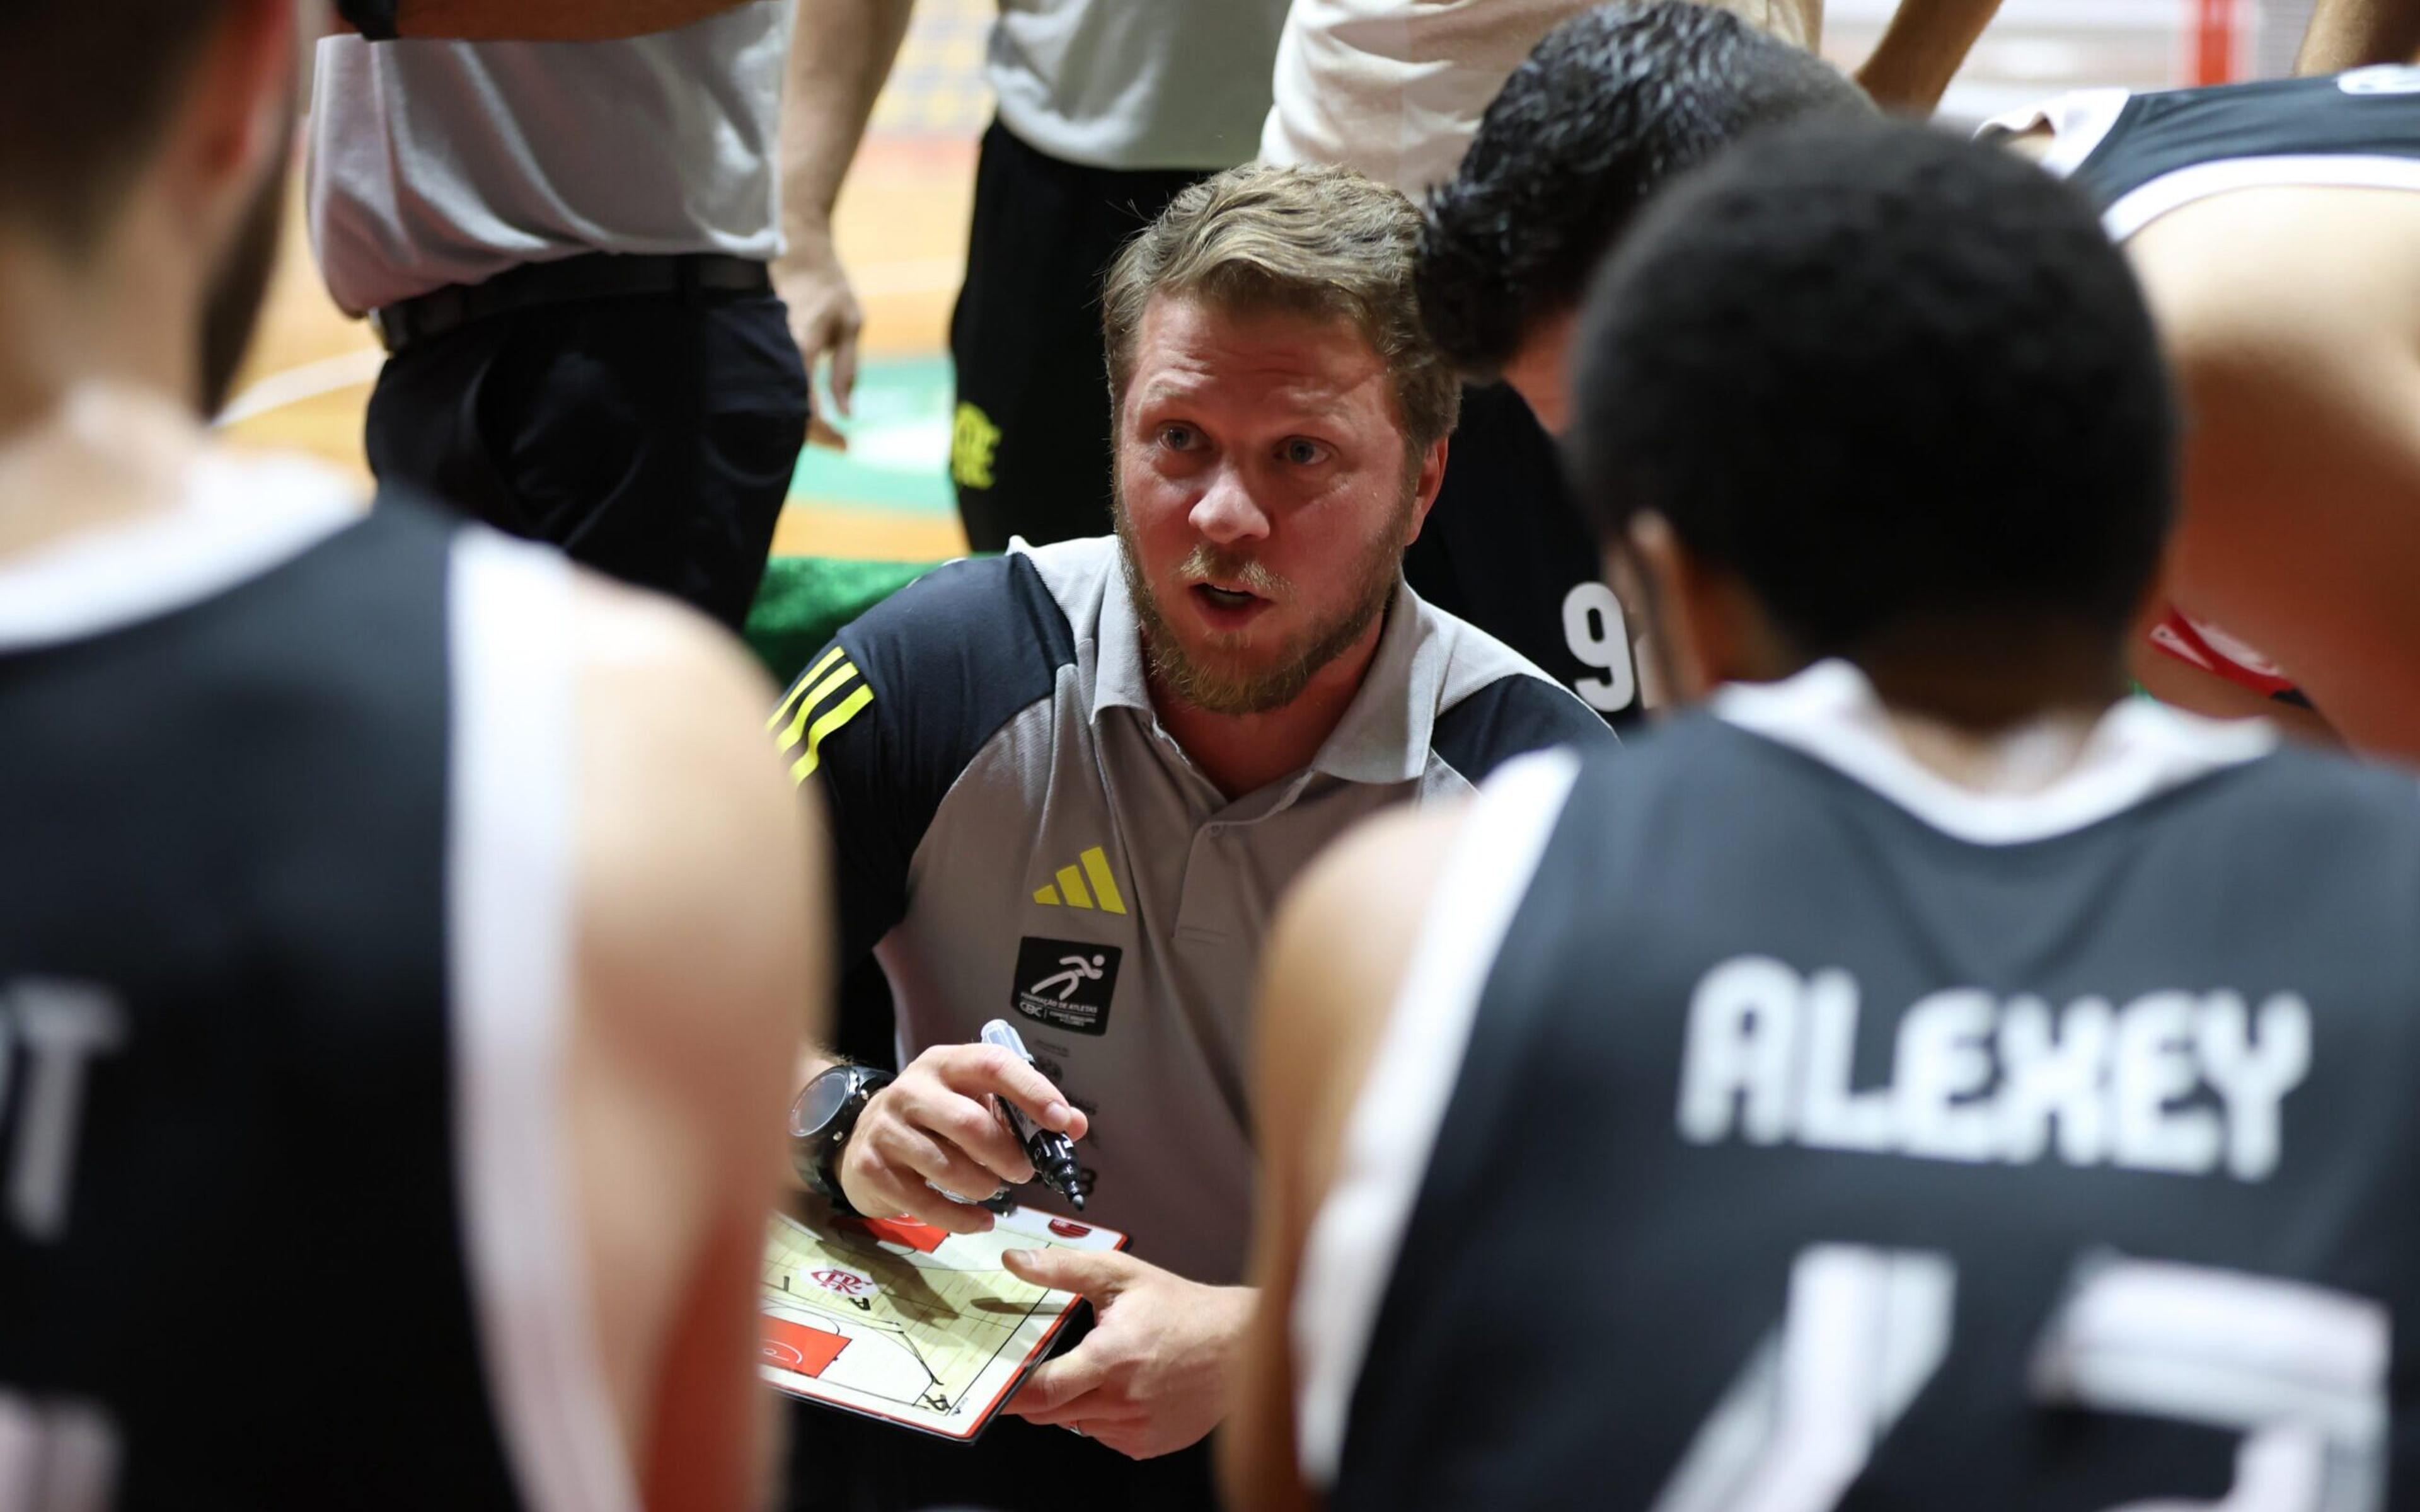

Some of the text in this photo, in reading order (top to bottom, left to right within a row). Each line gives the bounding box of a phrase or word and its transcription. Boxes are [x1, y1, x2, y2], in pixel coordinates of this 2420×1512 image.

[0, 975, 128, 1240] T
[1069, 1003, 1098, 1013] ATLETAS
[1676, 955, 2313, 1181] ALEXEY
